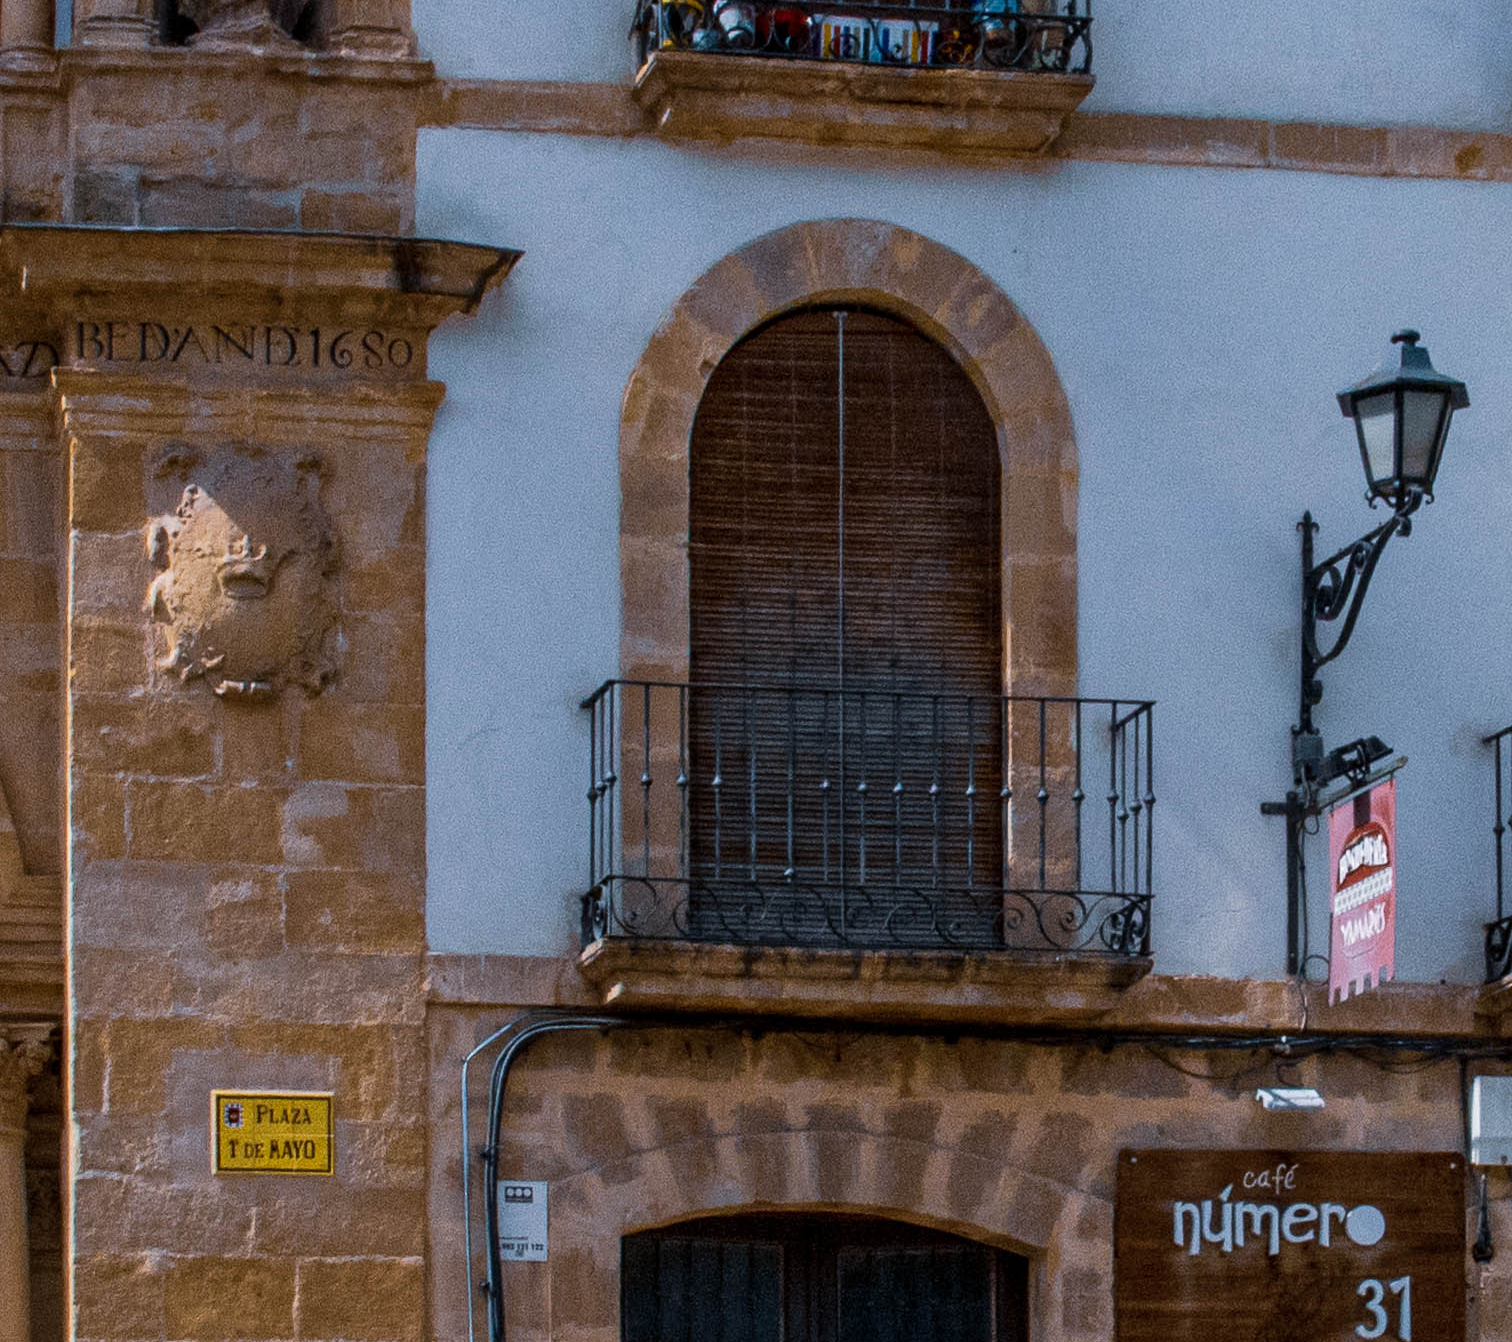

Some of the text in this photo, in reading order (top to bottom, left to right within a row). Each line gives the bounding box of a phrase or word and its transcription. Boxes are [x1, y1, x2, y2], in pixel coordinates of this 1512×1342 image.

[256, 1104, 312, 1125] PLAZA
[244, 1144, 264, 1159] DE
[269, 1139, 316, 1159] MAYO
[1242, 1163, 1298, 1196] café
[1173, 1184, 1386, 1257] número
[1355, 1275, 1412, 1342] 31
